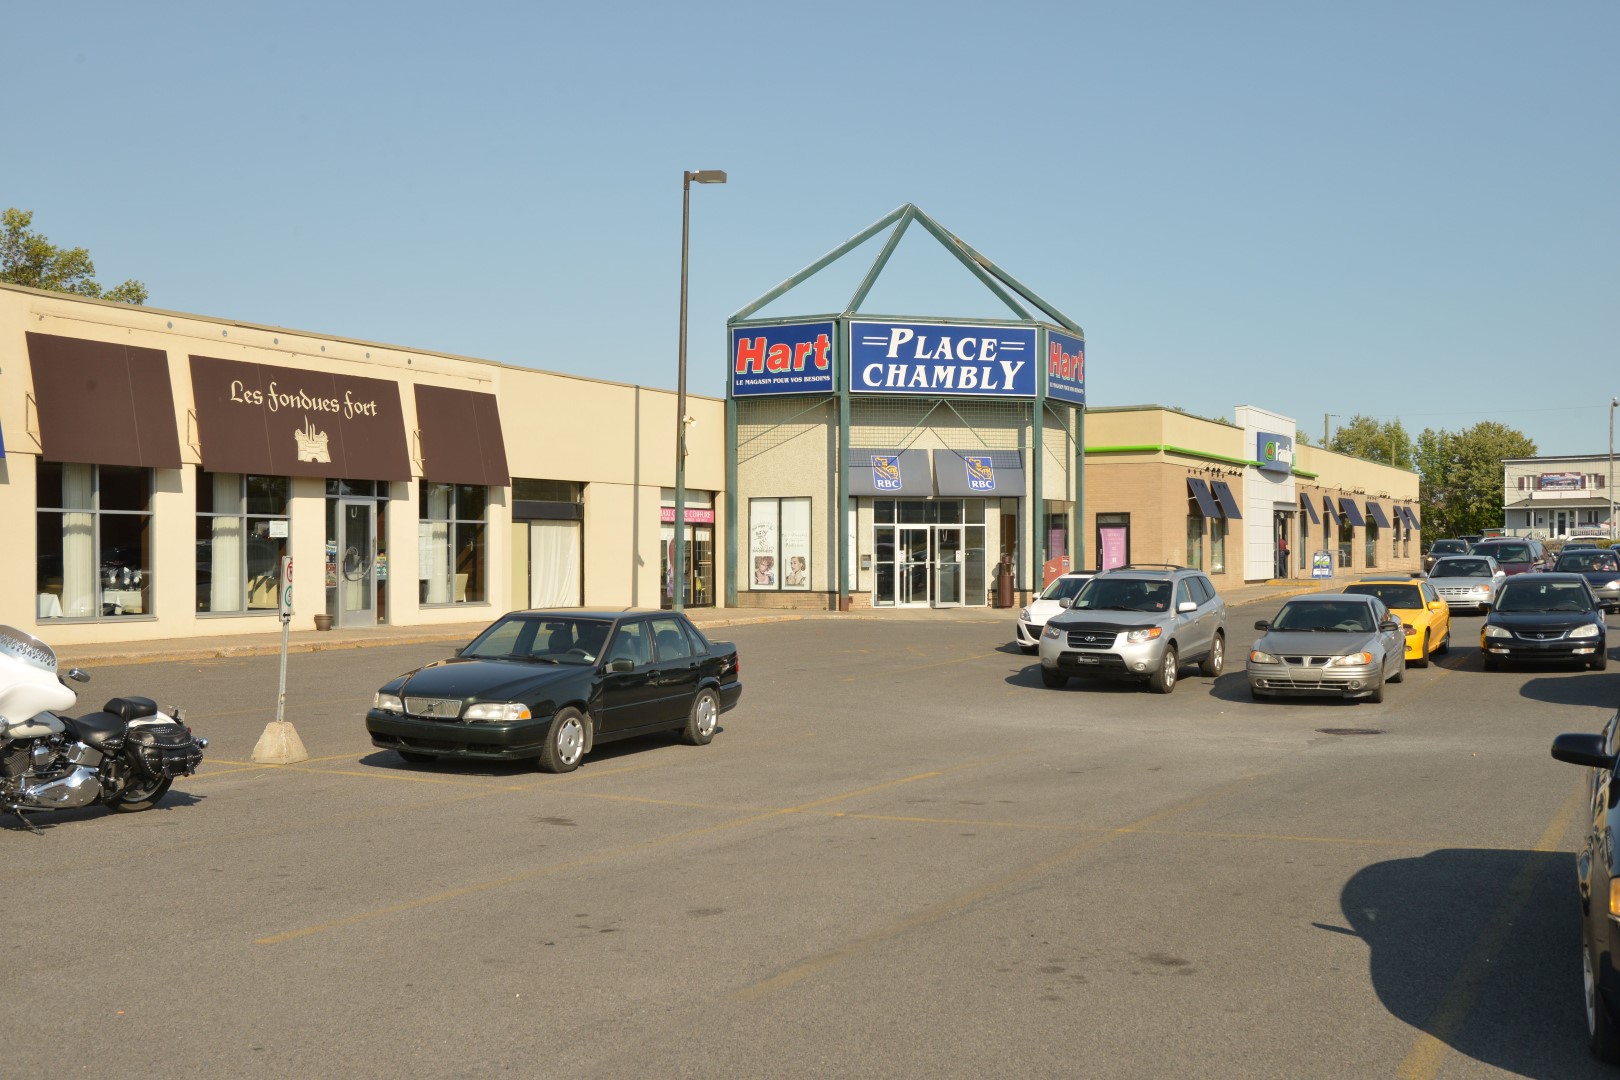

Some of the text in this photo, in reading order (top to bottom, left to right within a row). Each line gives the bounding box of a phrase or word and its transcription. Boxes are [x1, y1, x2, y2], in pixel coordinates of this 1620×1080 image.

[735, 333, 831, 374] Hart
[886, 327, 998, 362] PLACE
[1049, 340, 1084, 384] Hart
[862, 360, 1026, 390] CHAMBLY
[230, 380, 378, 420] Les fondues fort
[877, 479, 899, 488] RBC
[971, 480, 993, 489] RBC
